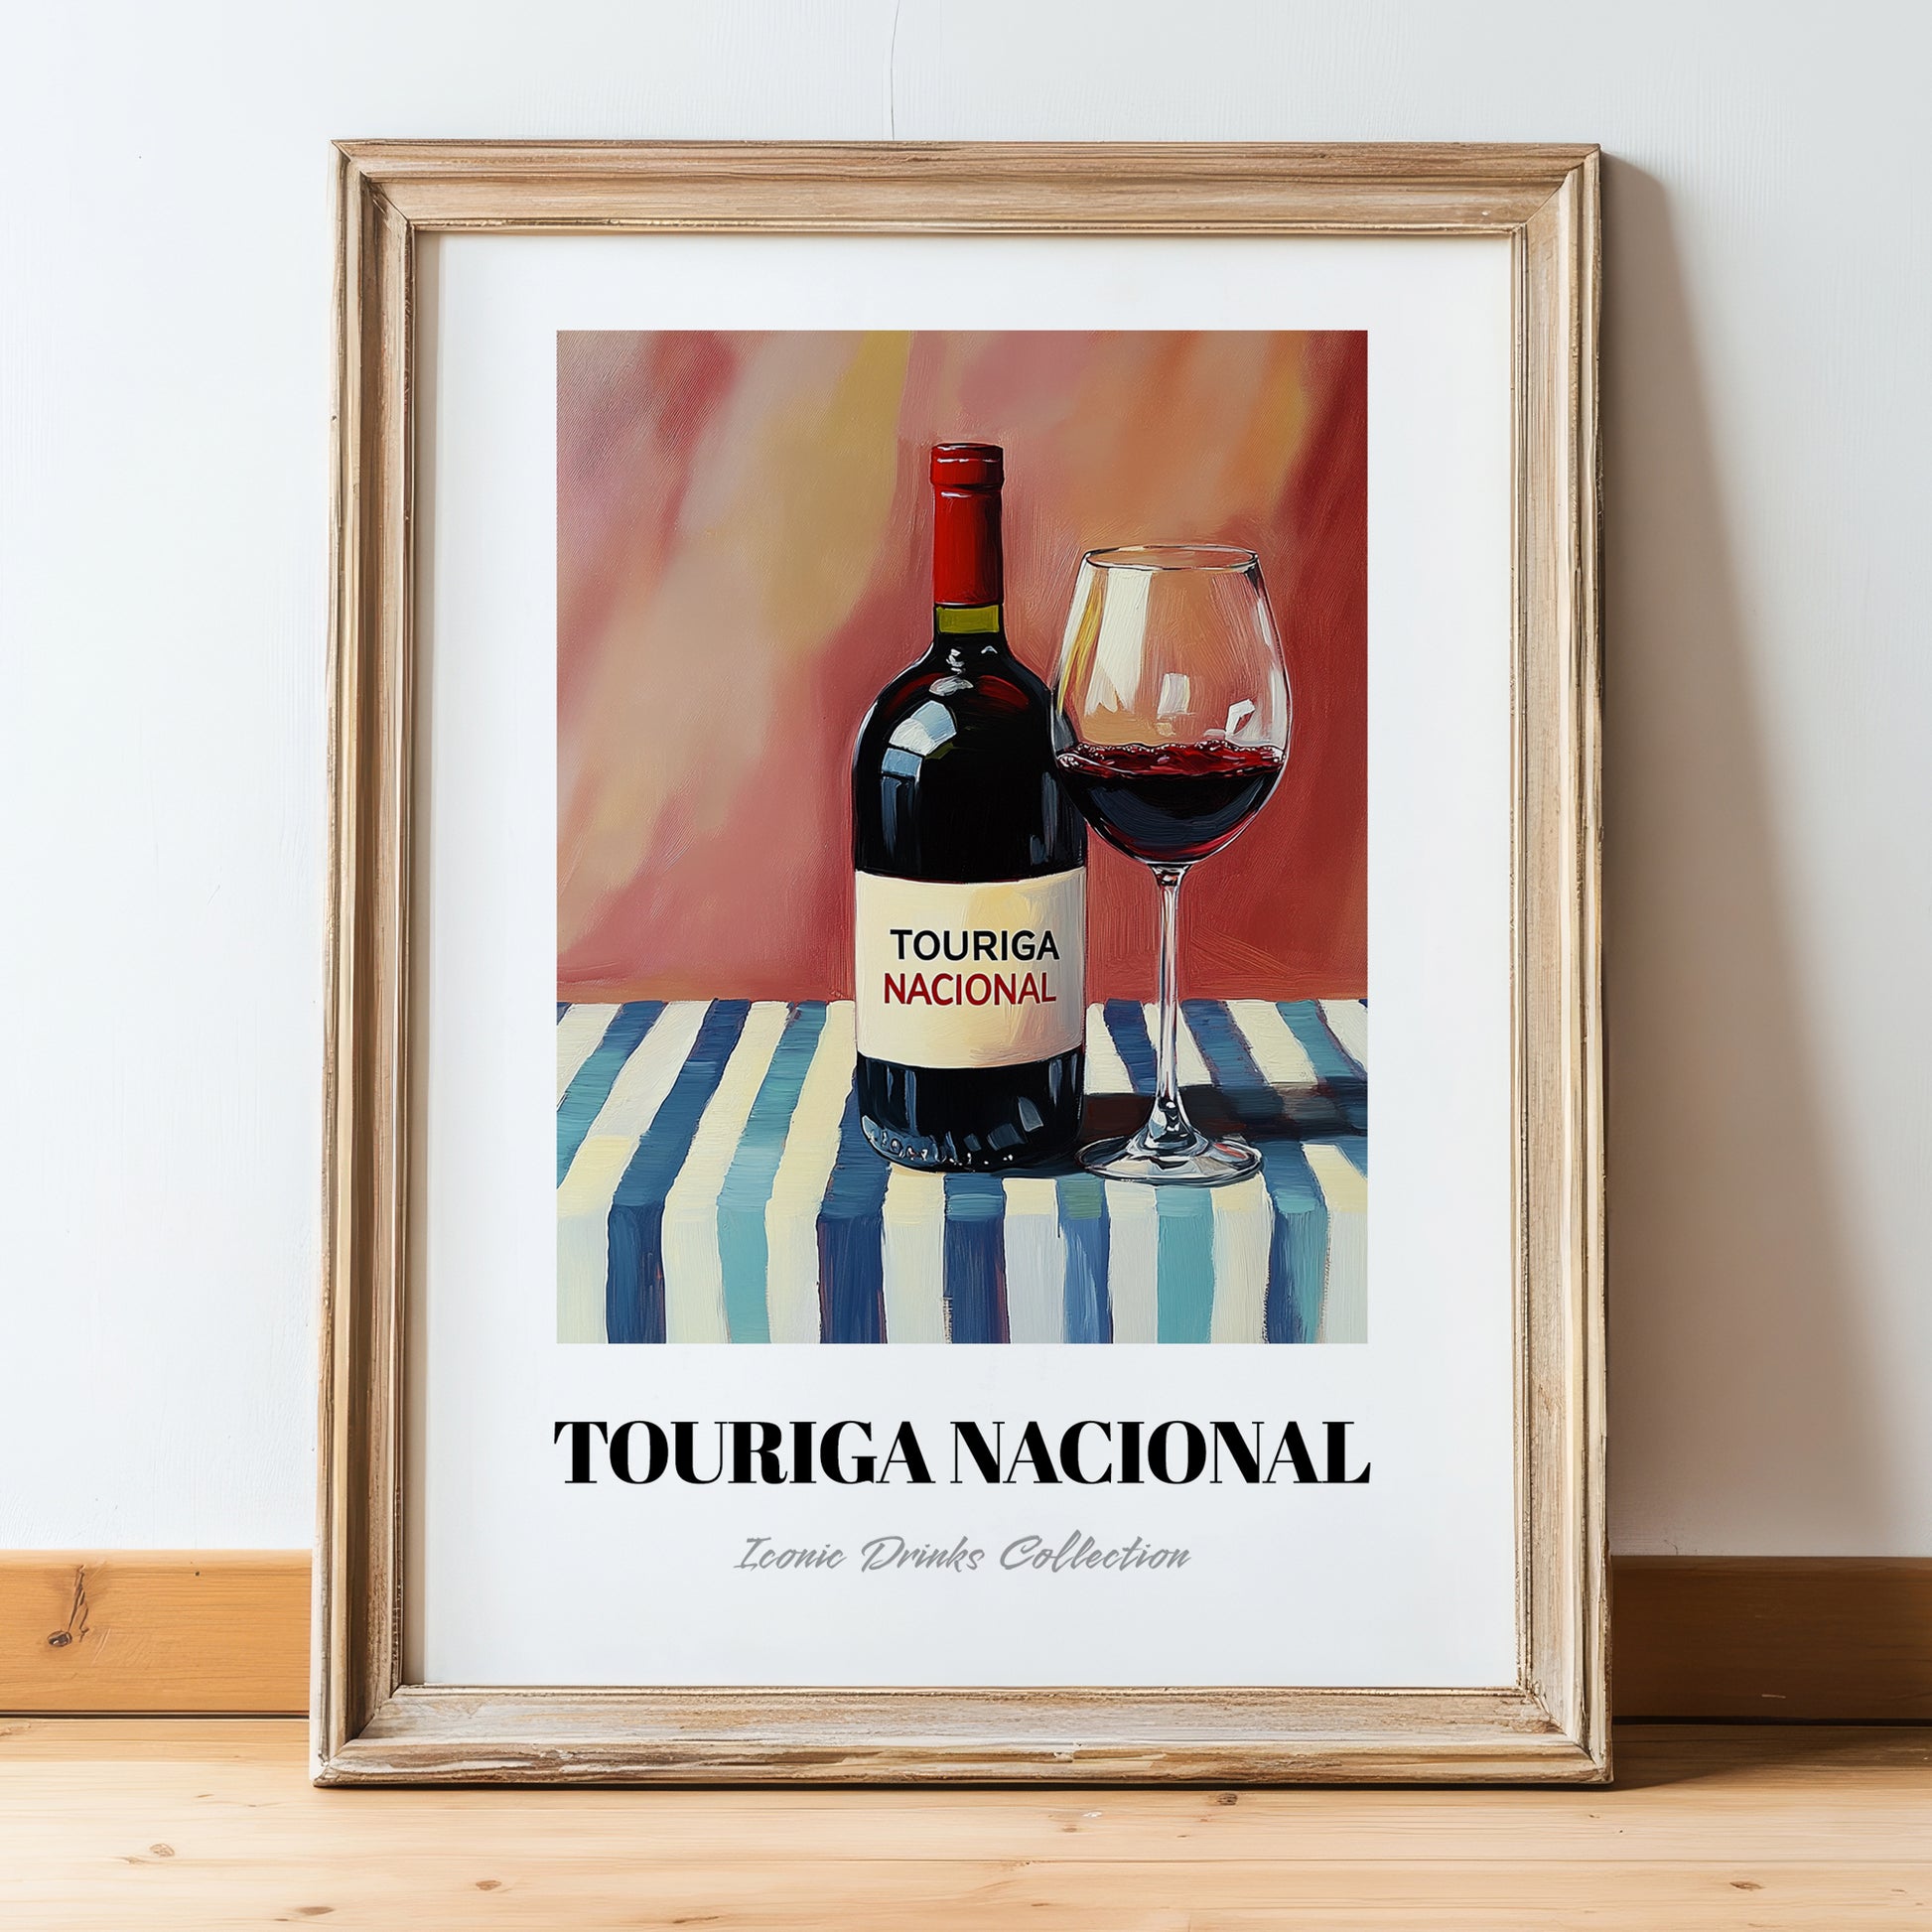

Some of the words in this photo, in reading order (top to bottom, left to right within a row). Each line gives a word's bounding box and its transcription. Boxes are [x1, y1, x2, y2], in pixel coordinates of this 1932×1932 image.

[890, 928, 1060, 961] TOURIGA
[884, 972, 1057, 1006] NACIONAL
[553, 1420, 936, 1485] TOURIGA
[949, 1420, 1372, 1485] NACIONAL
[733, 1536, 848, 1572] Iconic
[860, 1535, 986, 1574] Drinks
[999, 1528, 1192, 1574] Collection
